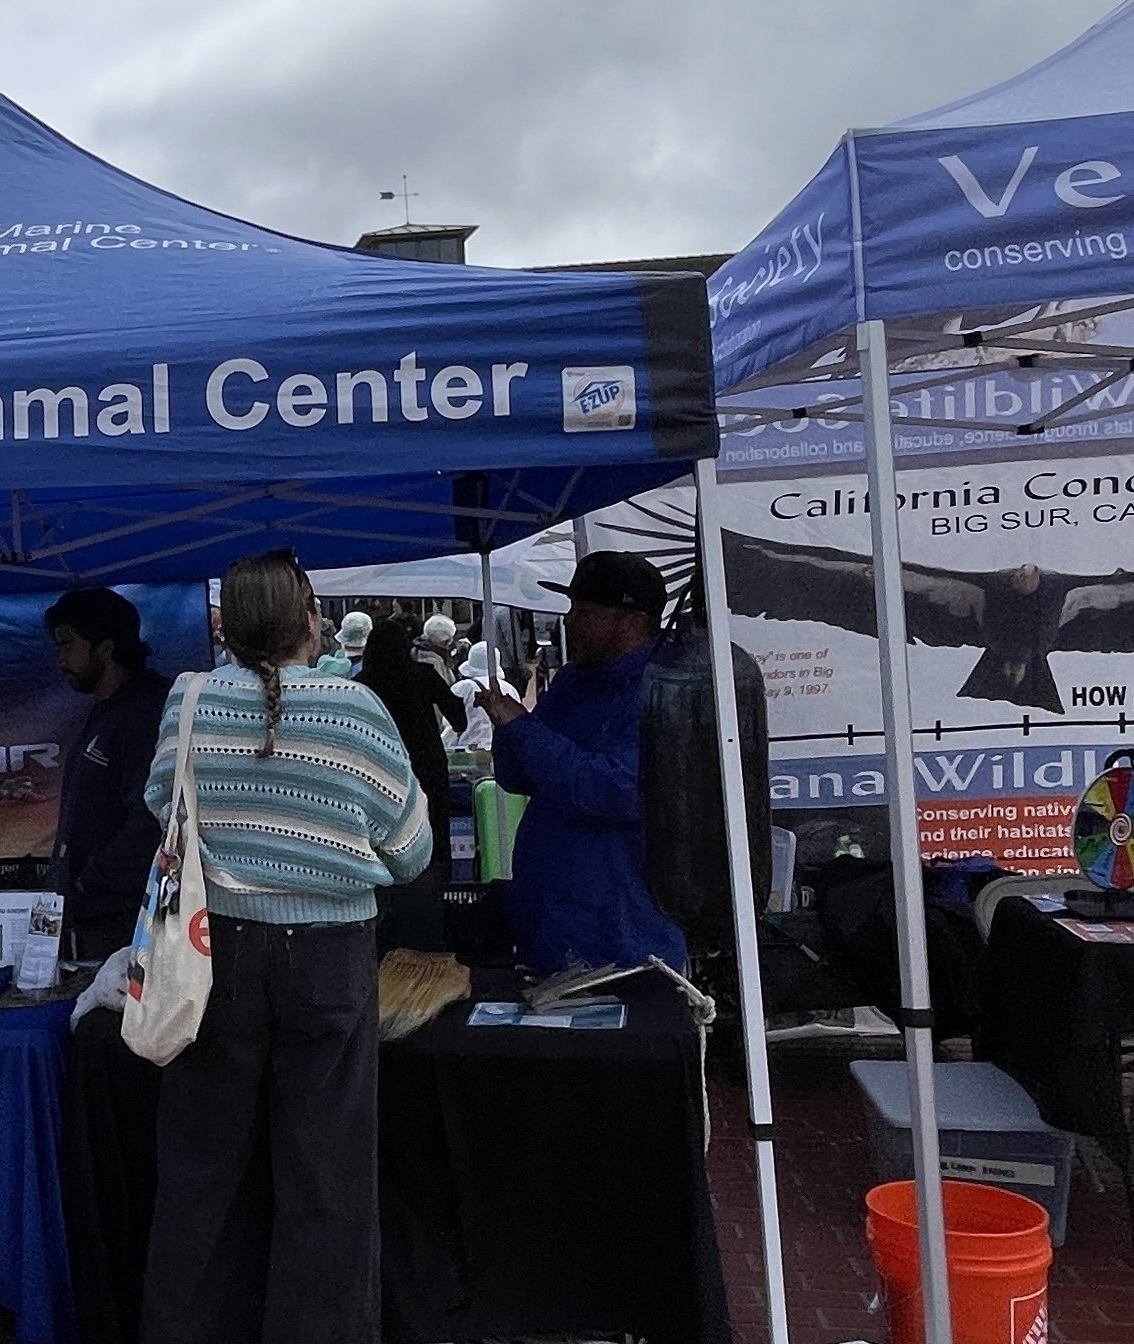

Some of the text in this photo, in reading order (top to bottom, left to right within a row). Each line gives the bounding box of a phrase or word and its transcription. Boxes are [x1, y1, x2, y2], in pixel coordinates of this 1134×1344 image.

[937, 146, 1127, 218] Ve
[89, 235, 262, 253] Center
[944, 230, 1128, 272] conserving
[204, 350, 529, 431] Center
[931, 514, 988, 536] BIG
[1001, 508, 1079, 532] SUR,
[1072, 686, 1127, 707] HOW
[950, 826, 992, 842] their
[997, 824, 1073, 839] habitats
